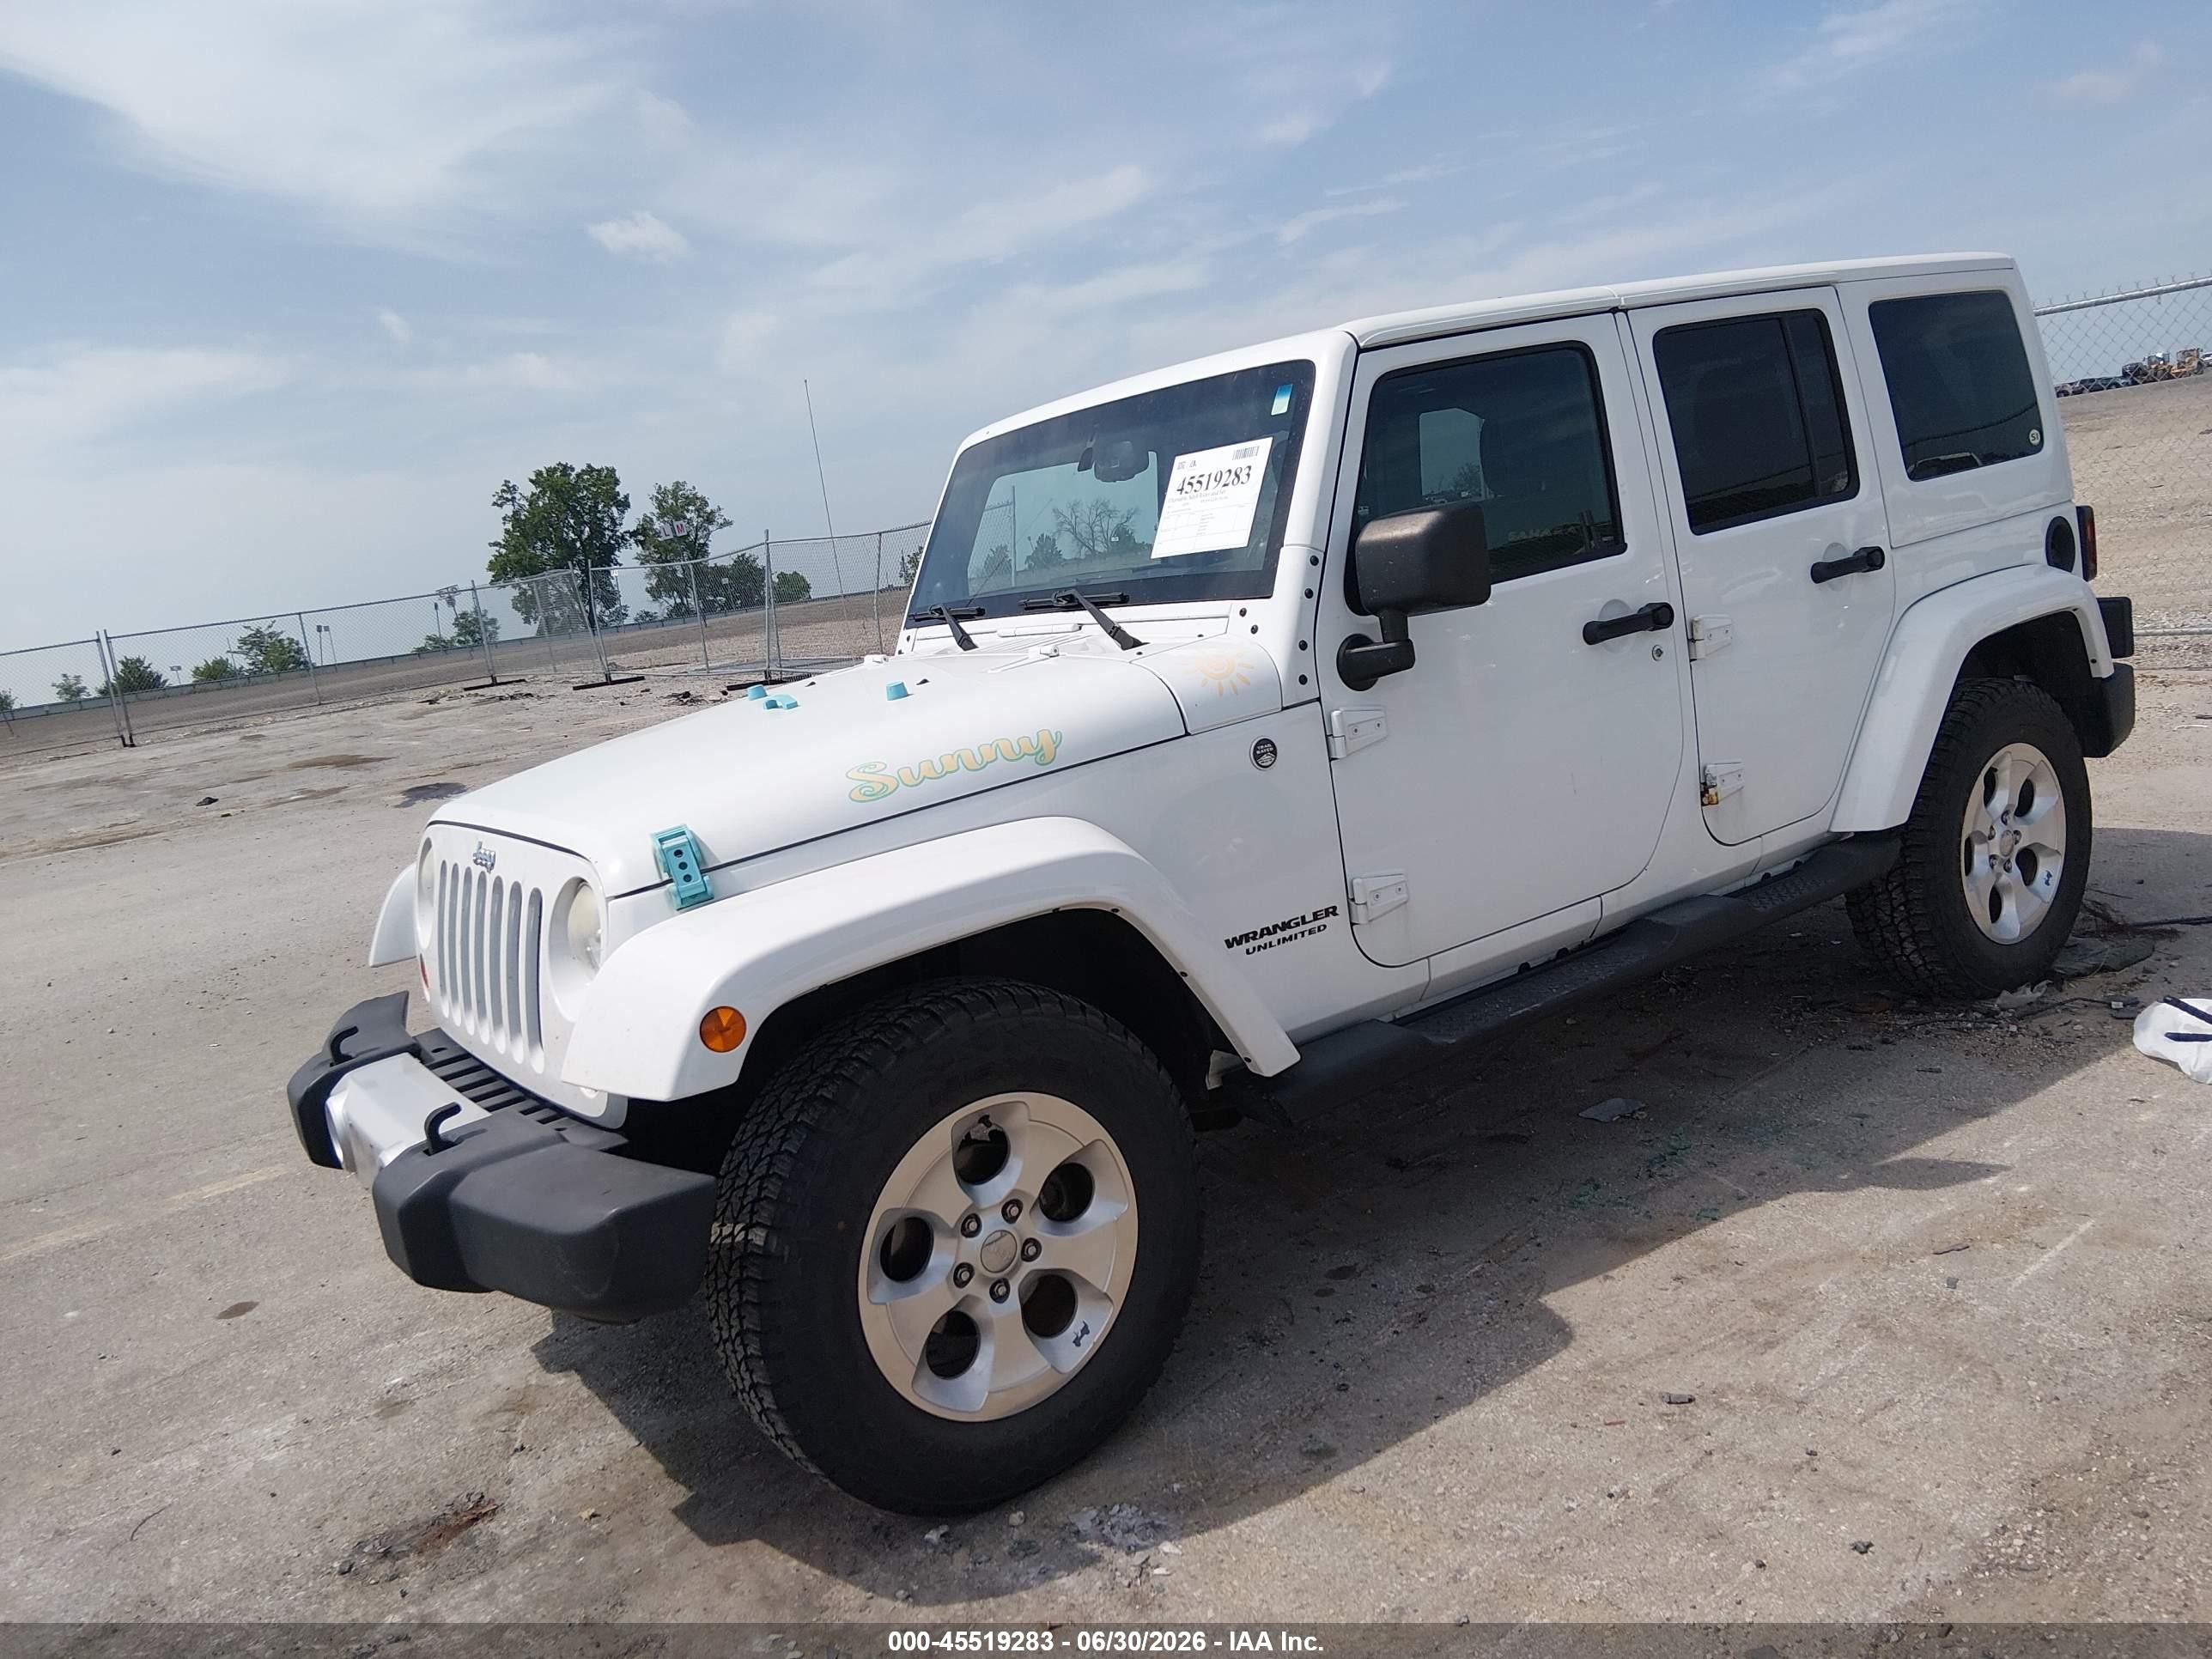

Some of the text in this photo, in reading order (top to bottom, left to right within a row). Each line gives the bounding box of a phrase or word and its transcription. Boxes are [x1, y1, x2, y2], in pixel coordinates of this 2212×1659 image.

[1176, 465, 1252, 495] 45519283
[662, 526, 671, 537] L
[676, 523, 685, 533] M
[846, 729, 1062, 803] Sunny
[1224, 905, 1340, 949] WRANGLER
[1245, 924, 1328, 956] UNLIMITED
